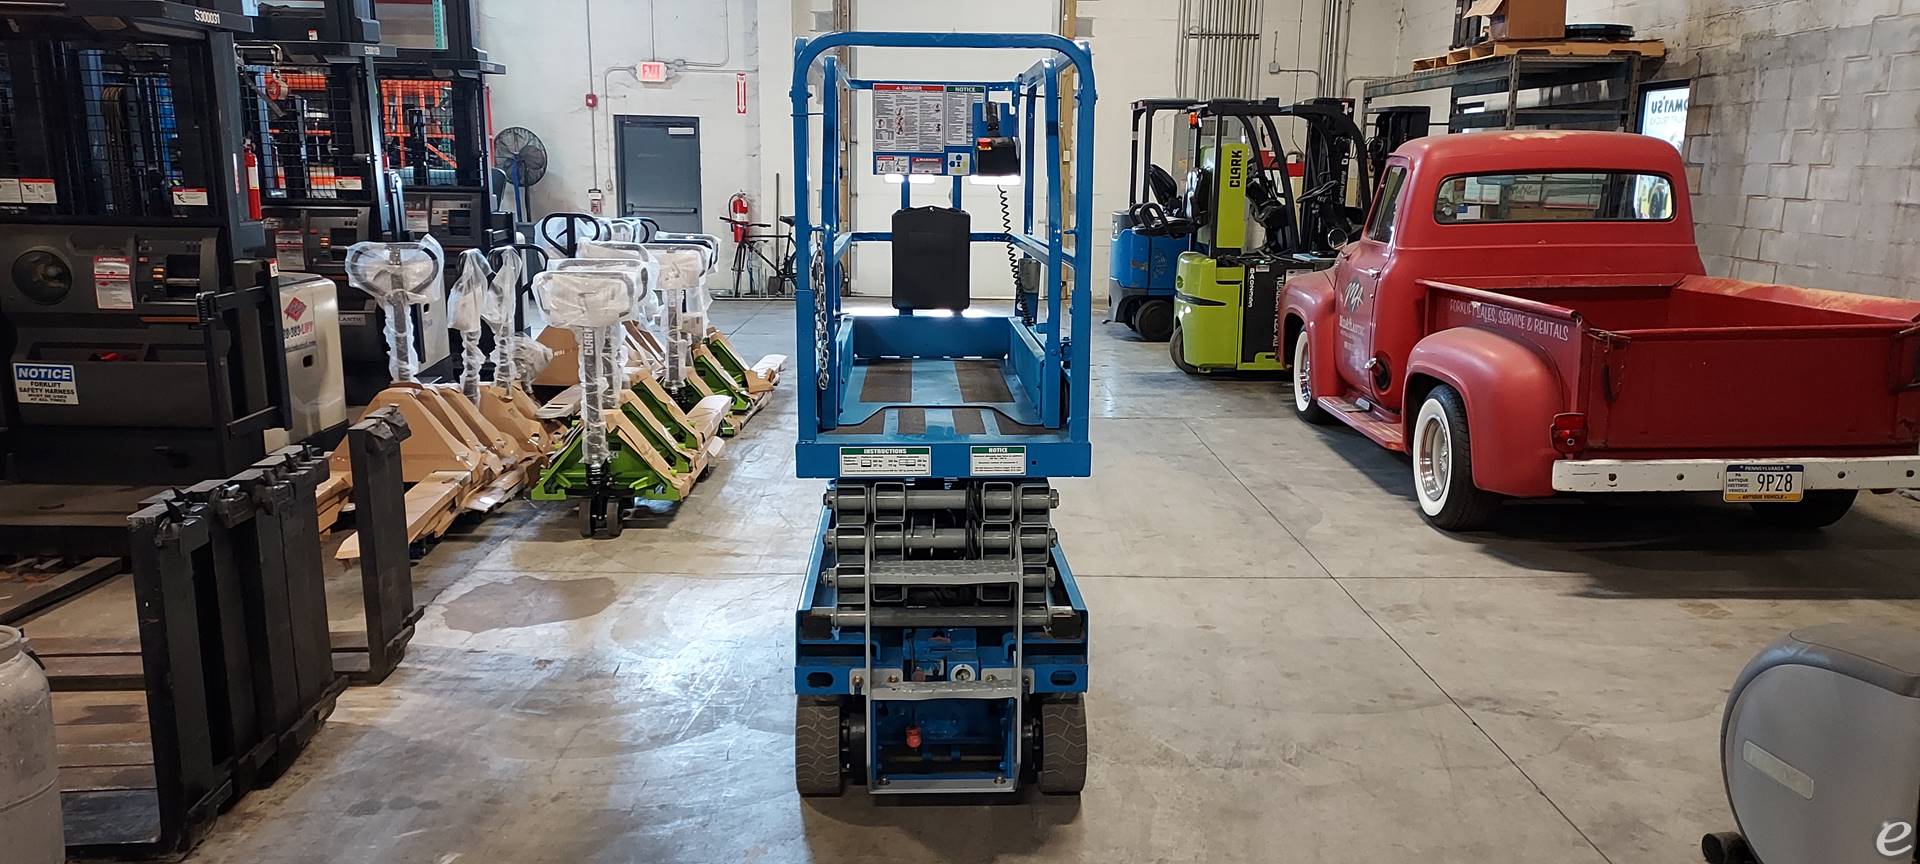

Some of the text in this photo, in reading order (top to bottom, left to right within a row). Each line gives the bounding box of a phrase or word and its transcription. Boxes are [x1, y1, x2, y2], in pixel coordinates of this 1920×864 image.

[642, 63, 660, 80] EXIT
[1229, 150, 1242, 188] CLARK
[1449, 299, 1569, 341] FORKLIFT SALES, SERVICE & RENTALS
[18, 367, 71, 380] NOTICE
[1757, 473, 1793, 492] 9PZ8
